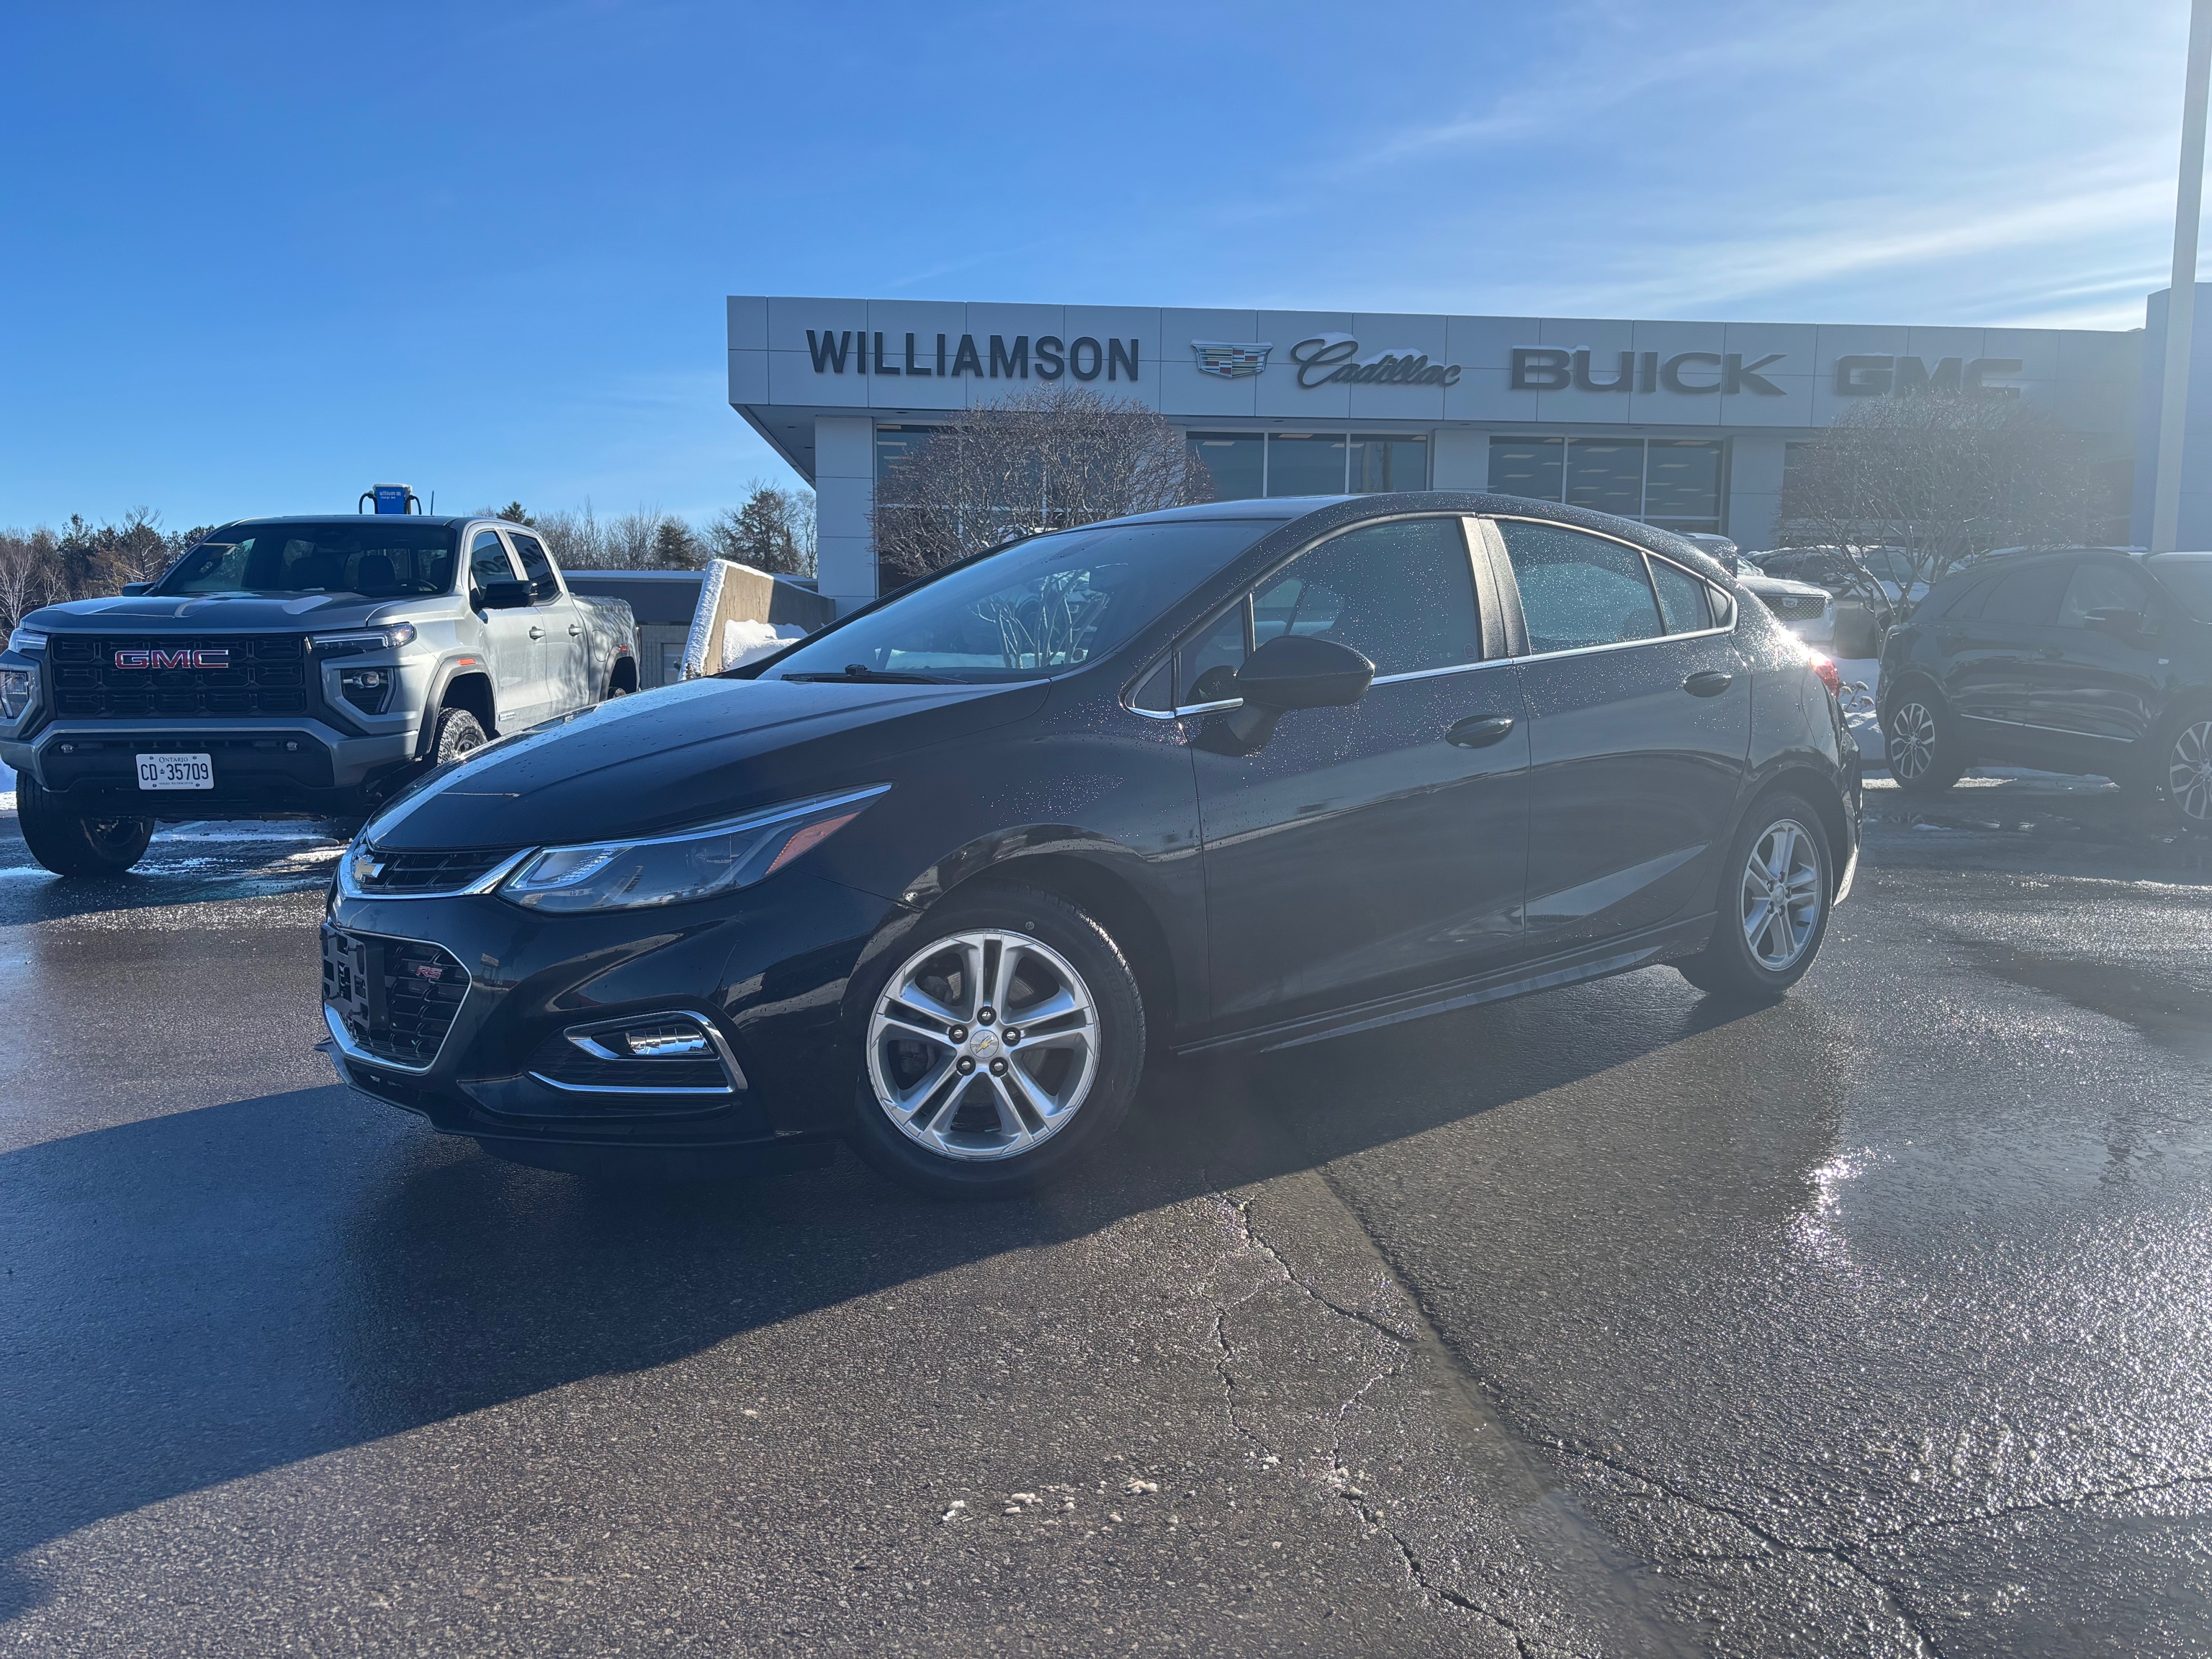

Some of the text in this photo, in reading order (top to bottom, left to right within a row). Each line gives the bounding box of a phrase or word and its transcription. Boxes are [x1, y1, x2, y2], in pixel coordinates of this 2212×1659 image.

[806, 329, 1139, 382] WILLIAMSON
[1291, 337, 1461, 389] Cadillac
[1511, 346, 1787, 395] BUICK
[1836, 354, 2023, 398] GMC
[115, 649, 229, 669] GMC
[140, 763, 209, 781] CD 35709
[416, 966, 443, 979] RS
